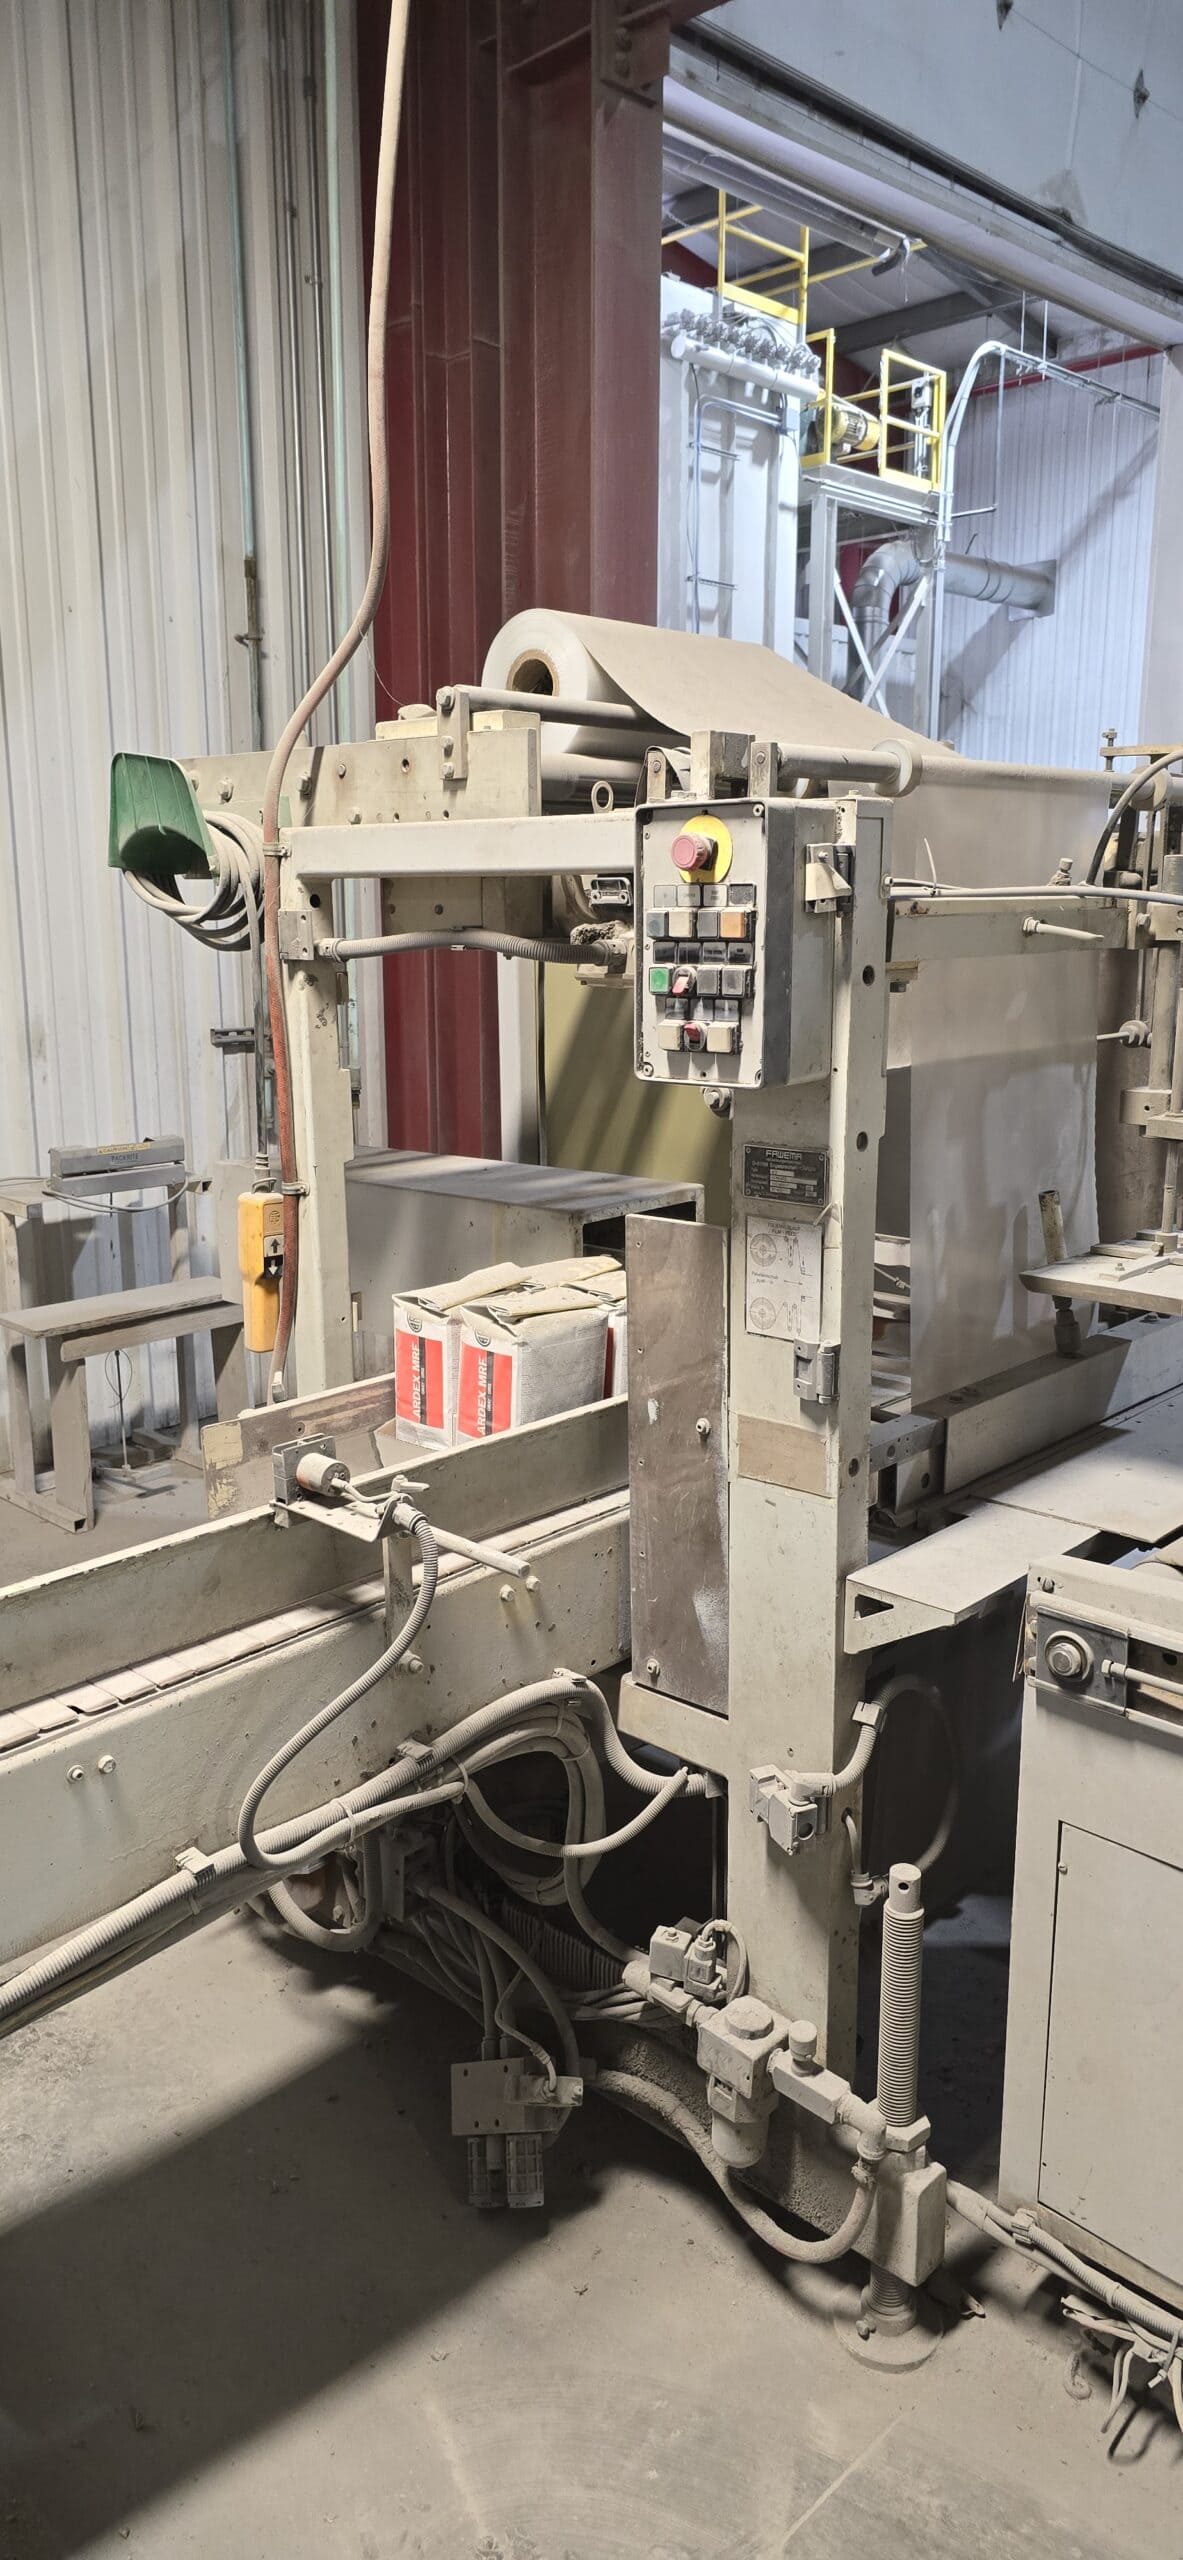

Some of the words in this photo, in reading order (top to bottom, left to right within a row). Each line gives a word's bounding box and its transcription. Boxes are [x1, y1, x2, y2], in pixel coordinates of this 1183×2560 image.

[765, 1150, 802, 1160] FAWEMA
[411, 1341, 420, 1372] MRF
[478, 1355, 488, 1387] MRF
[412, 1374, 421, 1419] ARDEX
[477, 1389, 487, 1436] ARDEX
